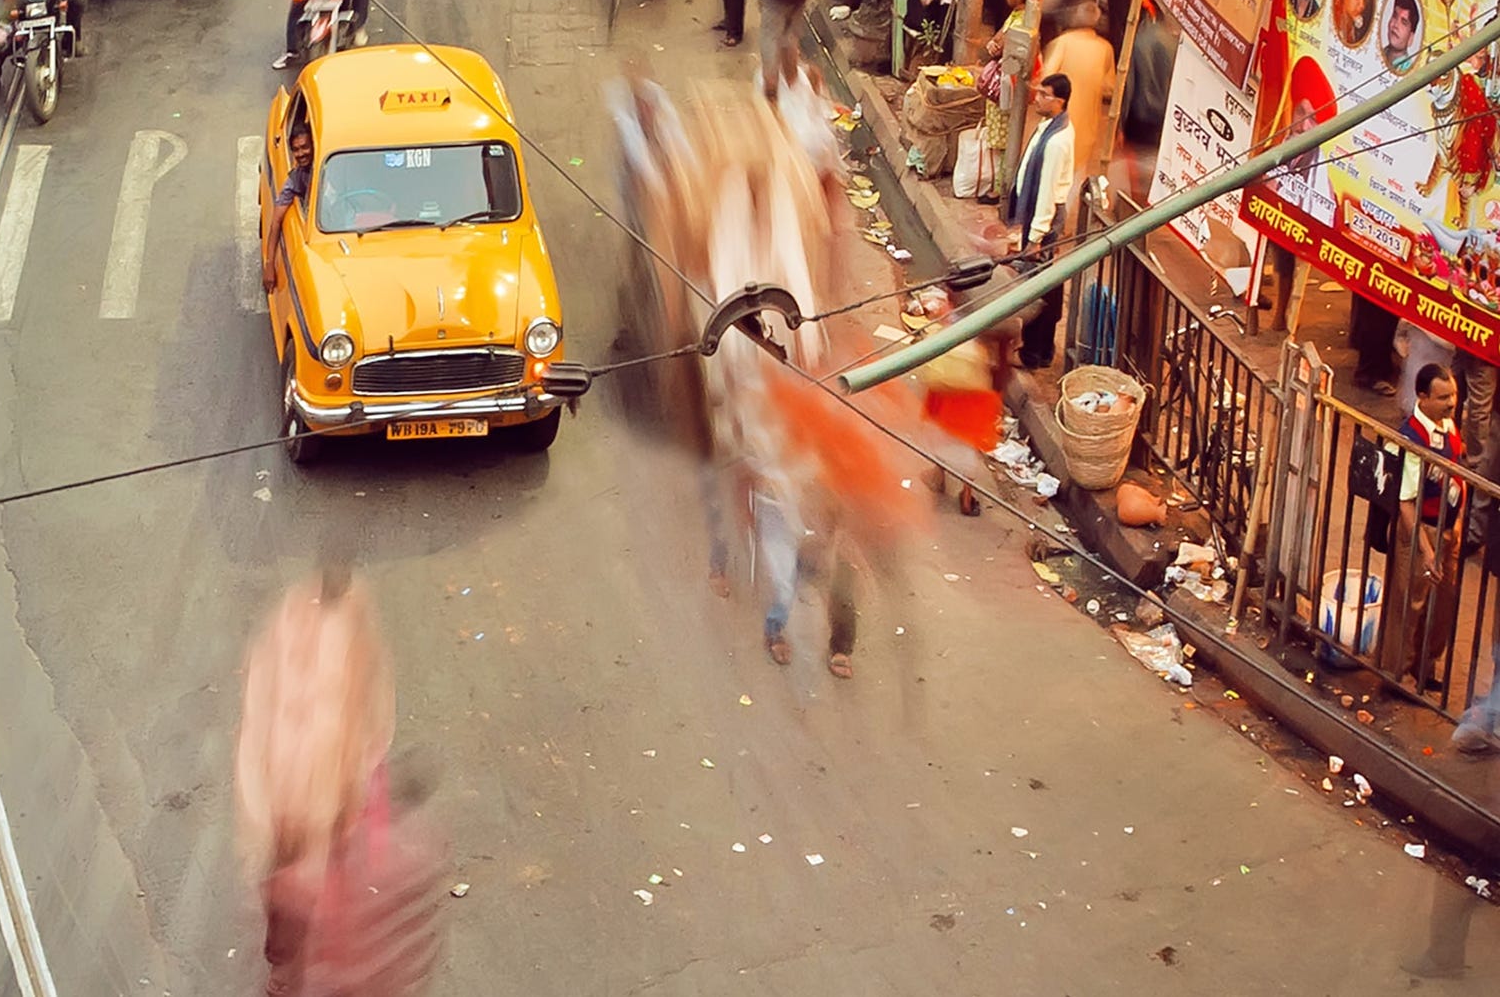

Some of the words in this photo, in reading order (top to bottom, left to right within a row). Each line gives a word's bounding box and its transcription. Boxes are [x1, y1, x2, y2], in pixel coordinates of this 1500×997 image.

[397, 93, 438, 104] TAXI
[405, 149, 432, 168] KGN
[1352, 214, 1401, 251] 25-1-2013
[1249, 195, 1314, 246] आयोजक-
[1318, 238, 1366, 280] हावड़ा
[1368, 262, 1413, 306] जिला
[1416, 293, 1494, 348] शालीमार
